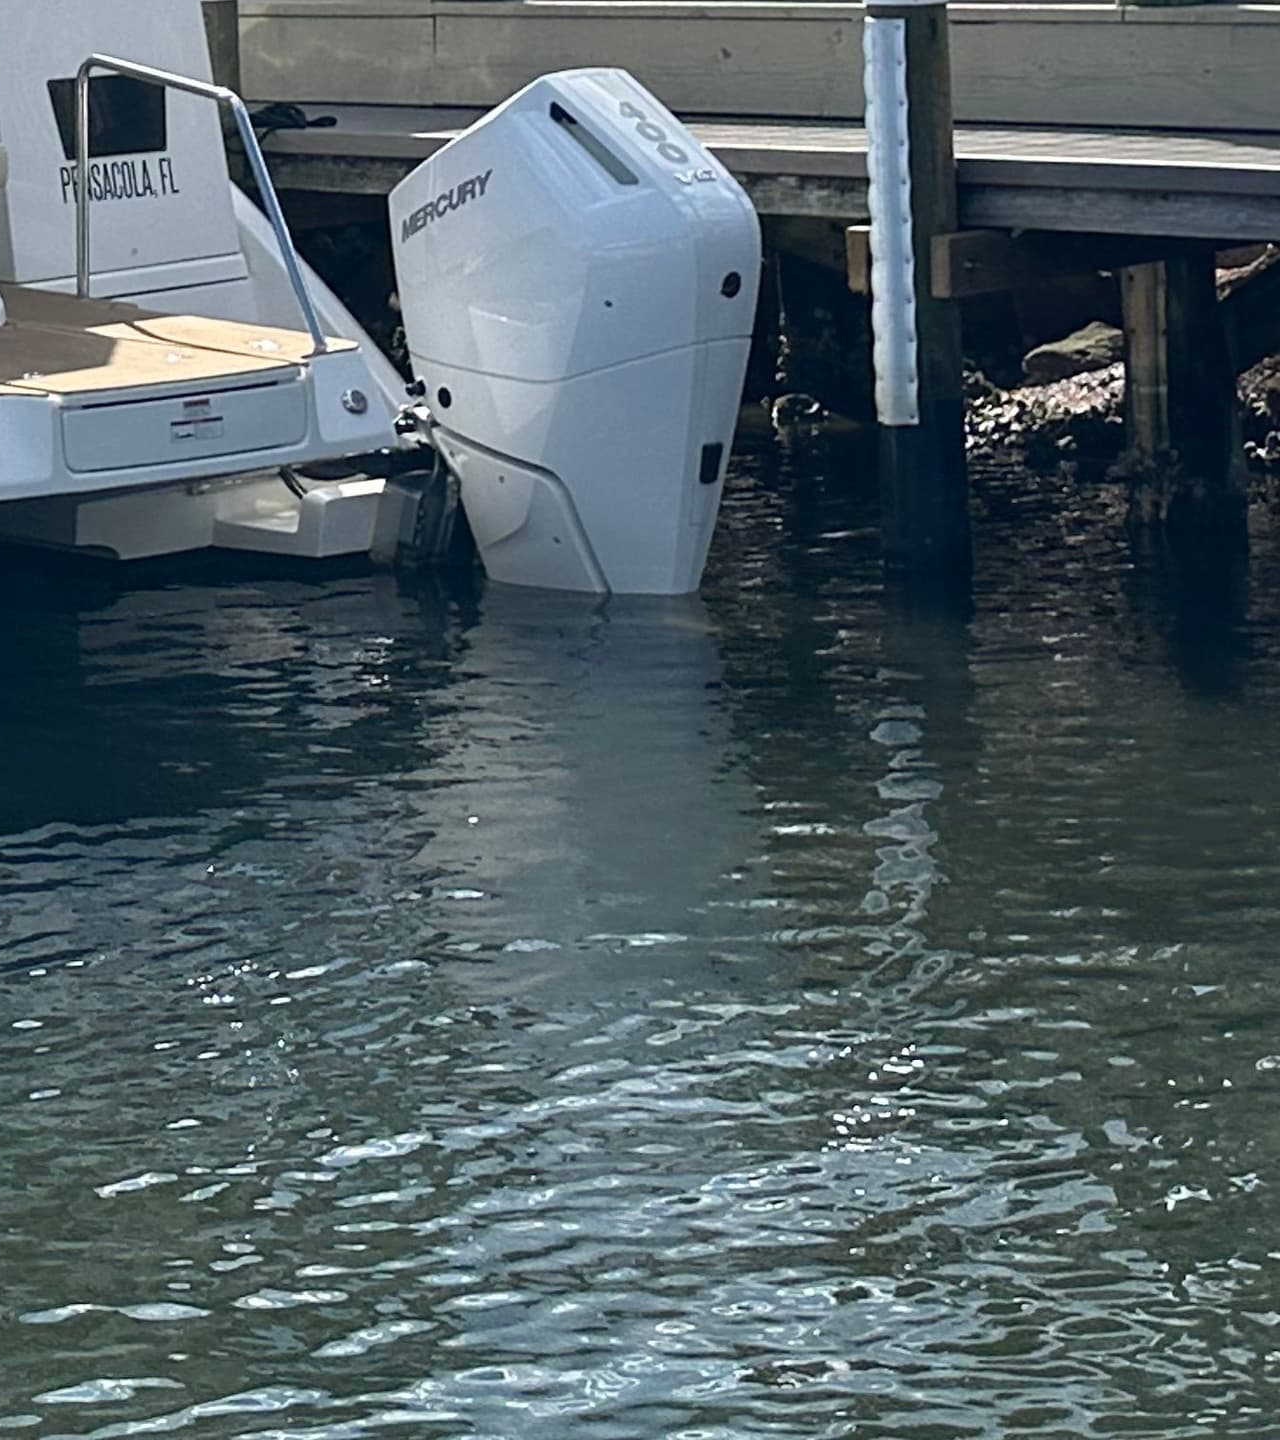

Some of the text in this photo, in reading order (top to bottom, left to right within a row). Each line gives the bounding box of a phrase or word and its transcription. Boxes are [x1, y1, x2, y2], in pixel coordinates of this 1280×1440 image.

[620, 101, 689, 164] 400
[159, 157, 179, 195] FL
[401, 168, 493, 243] MERCURY
